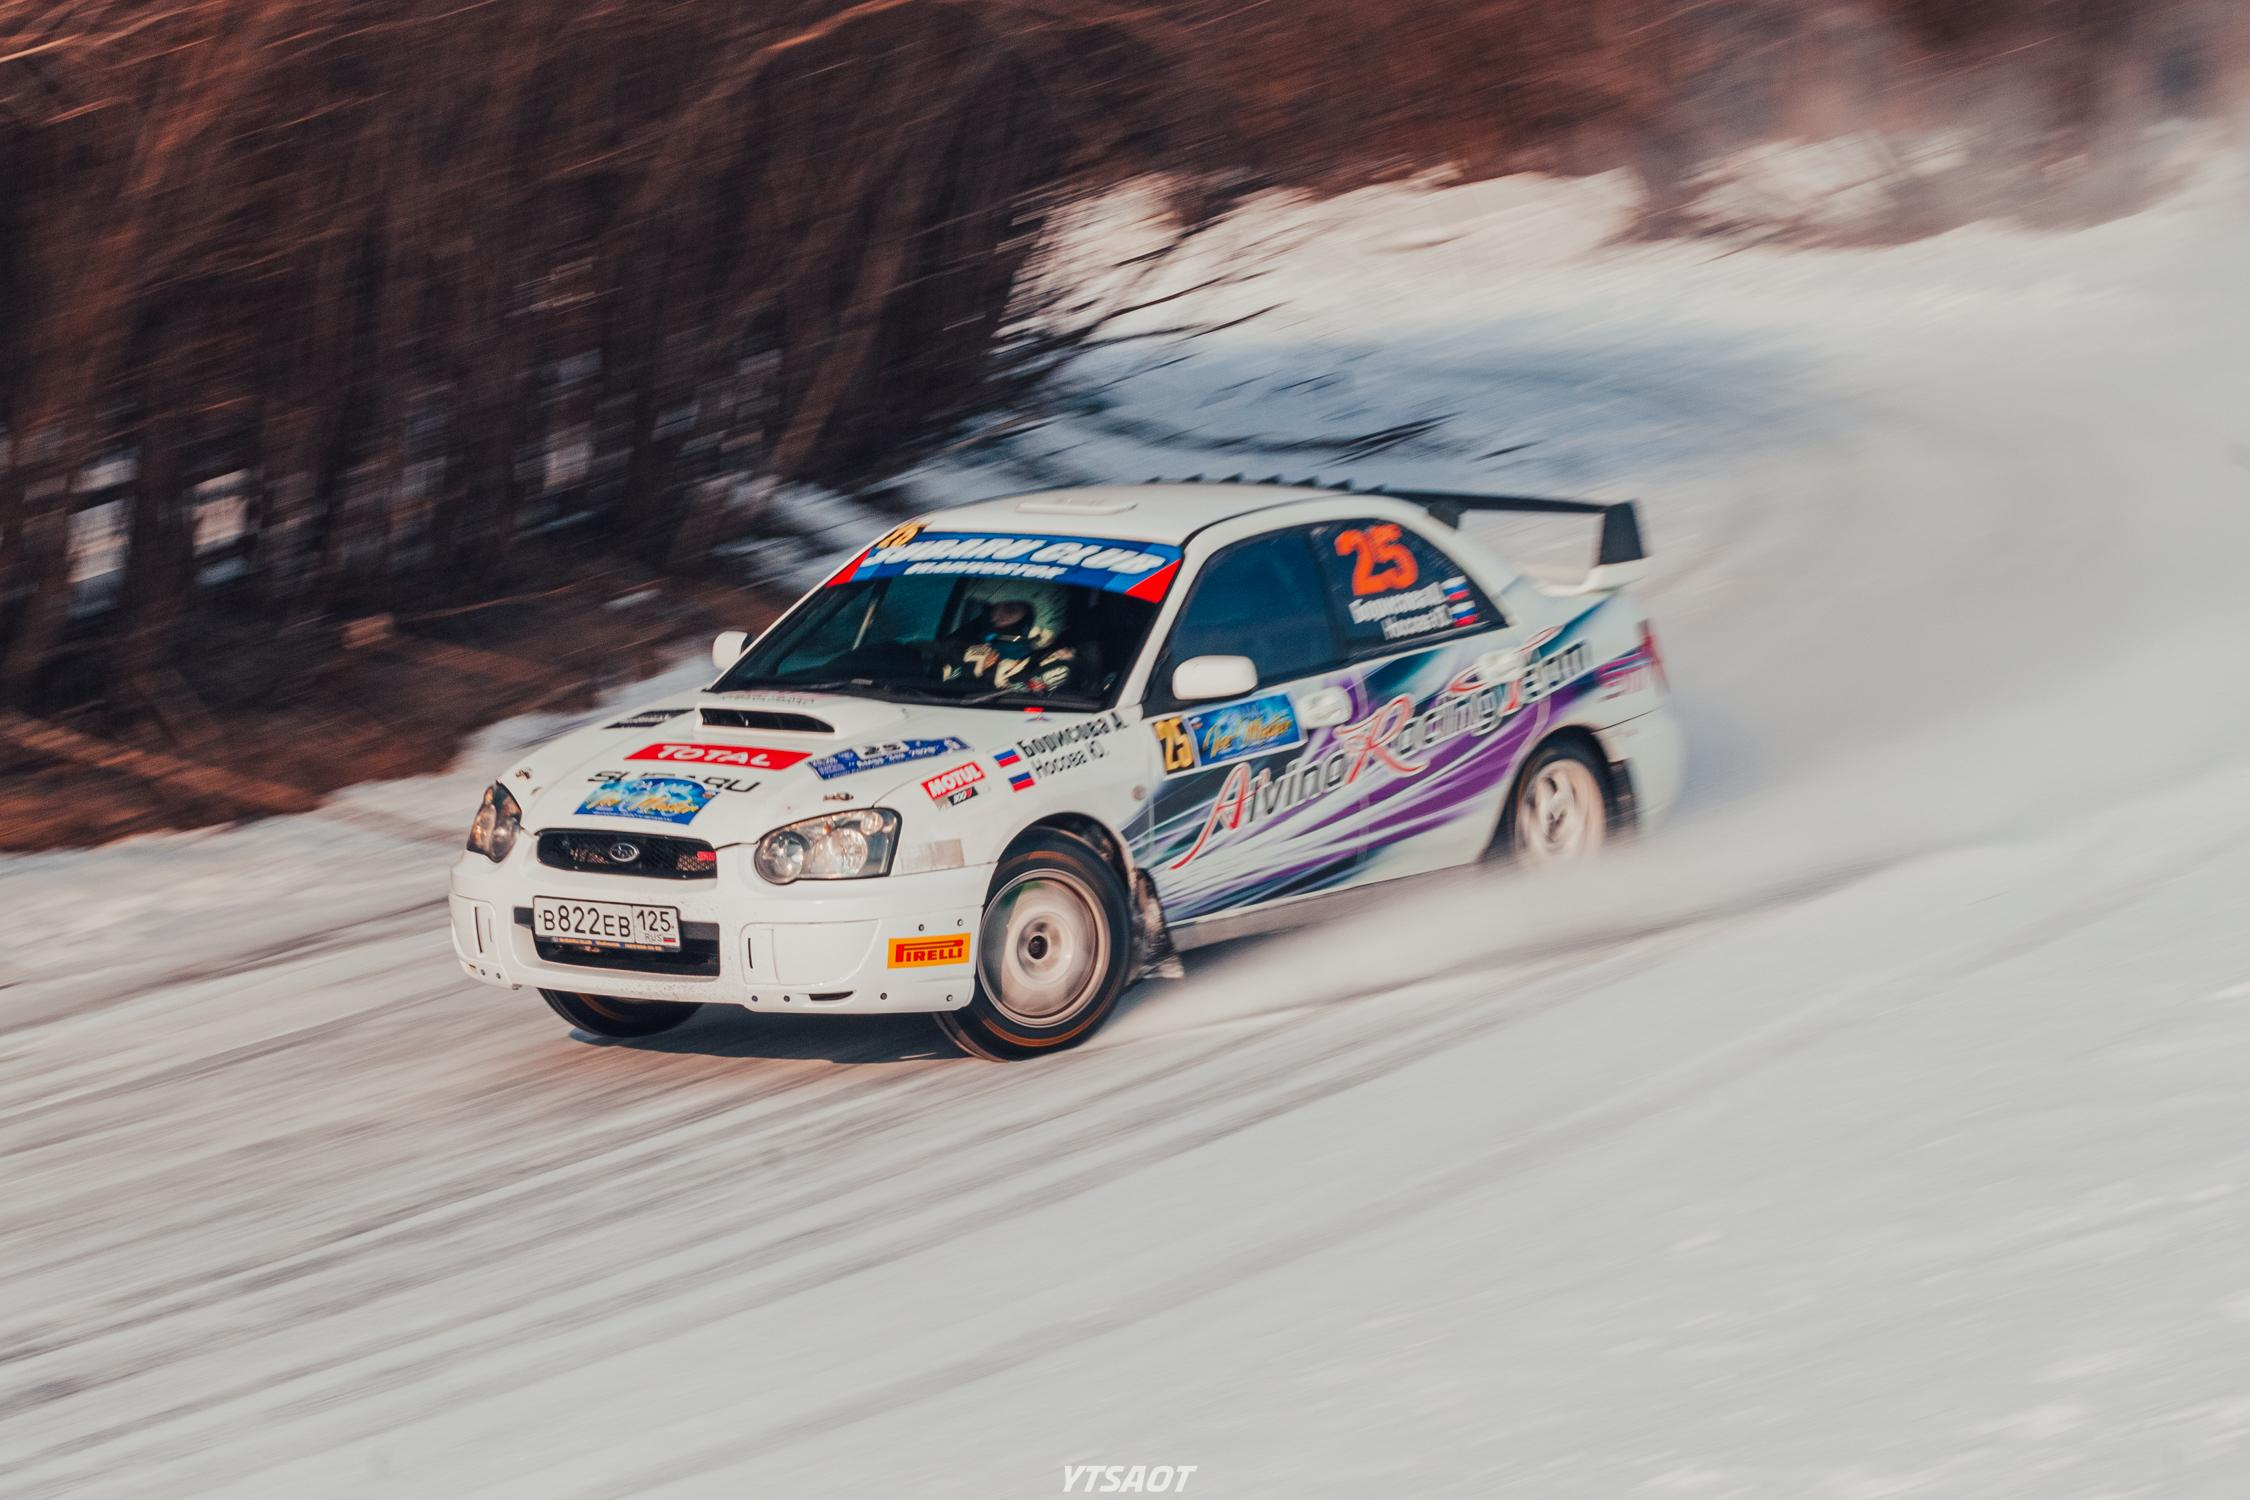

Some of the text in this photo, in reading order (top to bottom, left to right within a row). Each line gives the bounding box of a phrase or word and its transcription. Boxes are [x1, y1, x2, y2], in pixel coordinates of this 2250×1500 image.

[1334, 523, 1418, 596] 25
[1155, 716, 1194, 771] 25
[657, 745, 771, 768] TOTAL
[926, 763, 983, 797] MOTUL
[637, 909, 671, 932] 125
[645, 934, 662, 943] RUS
[895, 939, 964, 963] PIRELLI
